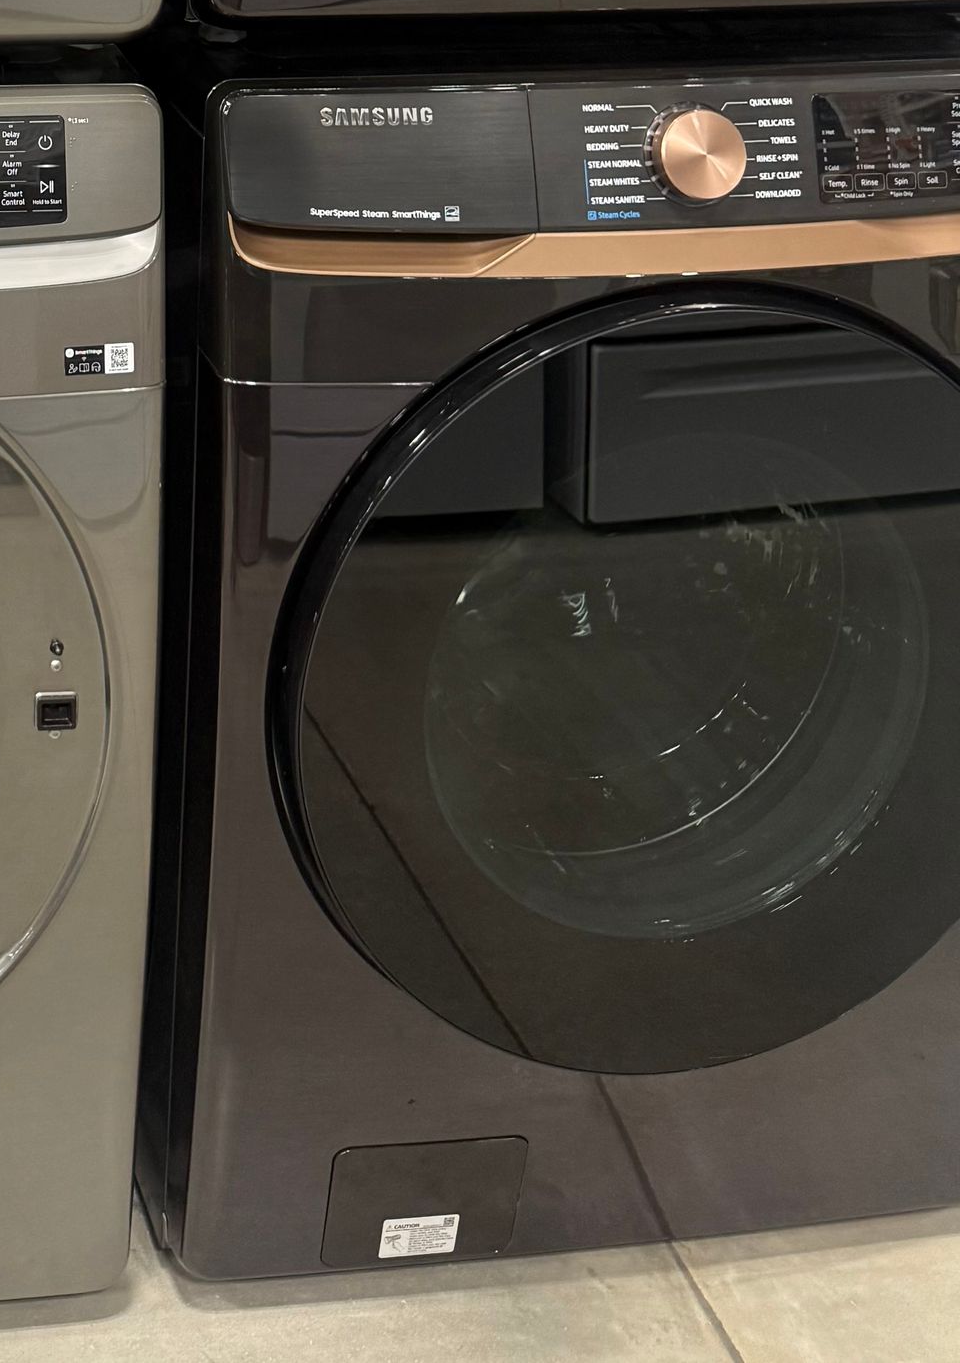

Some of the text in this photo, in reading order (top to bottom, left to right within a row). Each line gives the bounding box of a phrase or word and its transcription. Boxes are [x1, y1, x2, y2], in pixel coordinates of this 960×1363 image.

[749, 97, 792, 107] QUICK WASH
[582, 104, 615, 112] NORMAL
[319, 107, 434, 127] SAMSUNG
[758, 119, 795, 127] DELICATES
[584, 125, 629, 133] HEAVY DUTY
[2, 131, 20, 139] Delay
[770, 136, 797, 144] TOWELS
[586, 142, 620, 151] BEDDING
[2, 160, 22, 168] Alarm
[587, 158, 642, 169] STEAM NORMAL
[7, 168, 18, 176] Off
[759, 172, 776, 181] SELF
[589, 177, 640, 186] STEAM WHITES
[828, 179, 848, 188] Temp.
[860, 178, 879, 186] Rinse
[894, 177, 909, 186] Spin
[926, 176, 939, 184] Soil
[3, 190, 23, 198] Smart
[755, 189, 801, 199] DOWNLOADED
[1, 198, 25, 206] Control
[591, 195, 645, 205] STEAM SANITIZE
[310, 207, 441, 221] SuperSpeed Steam SmartThings
[597, 211, 640, 220] Steam Cycles
